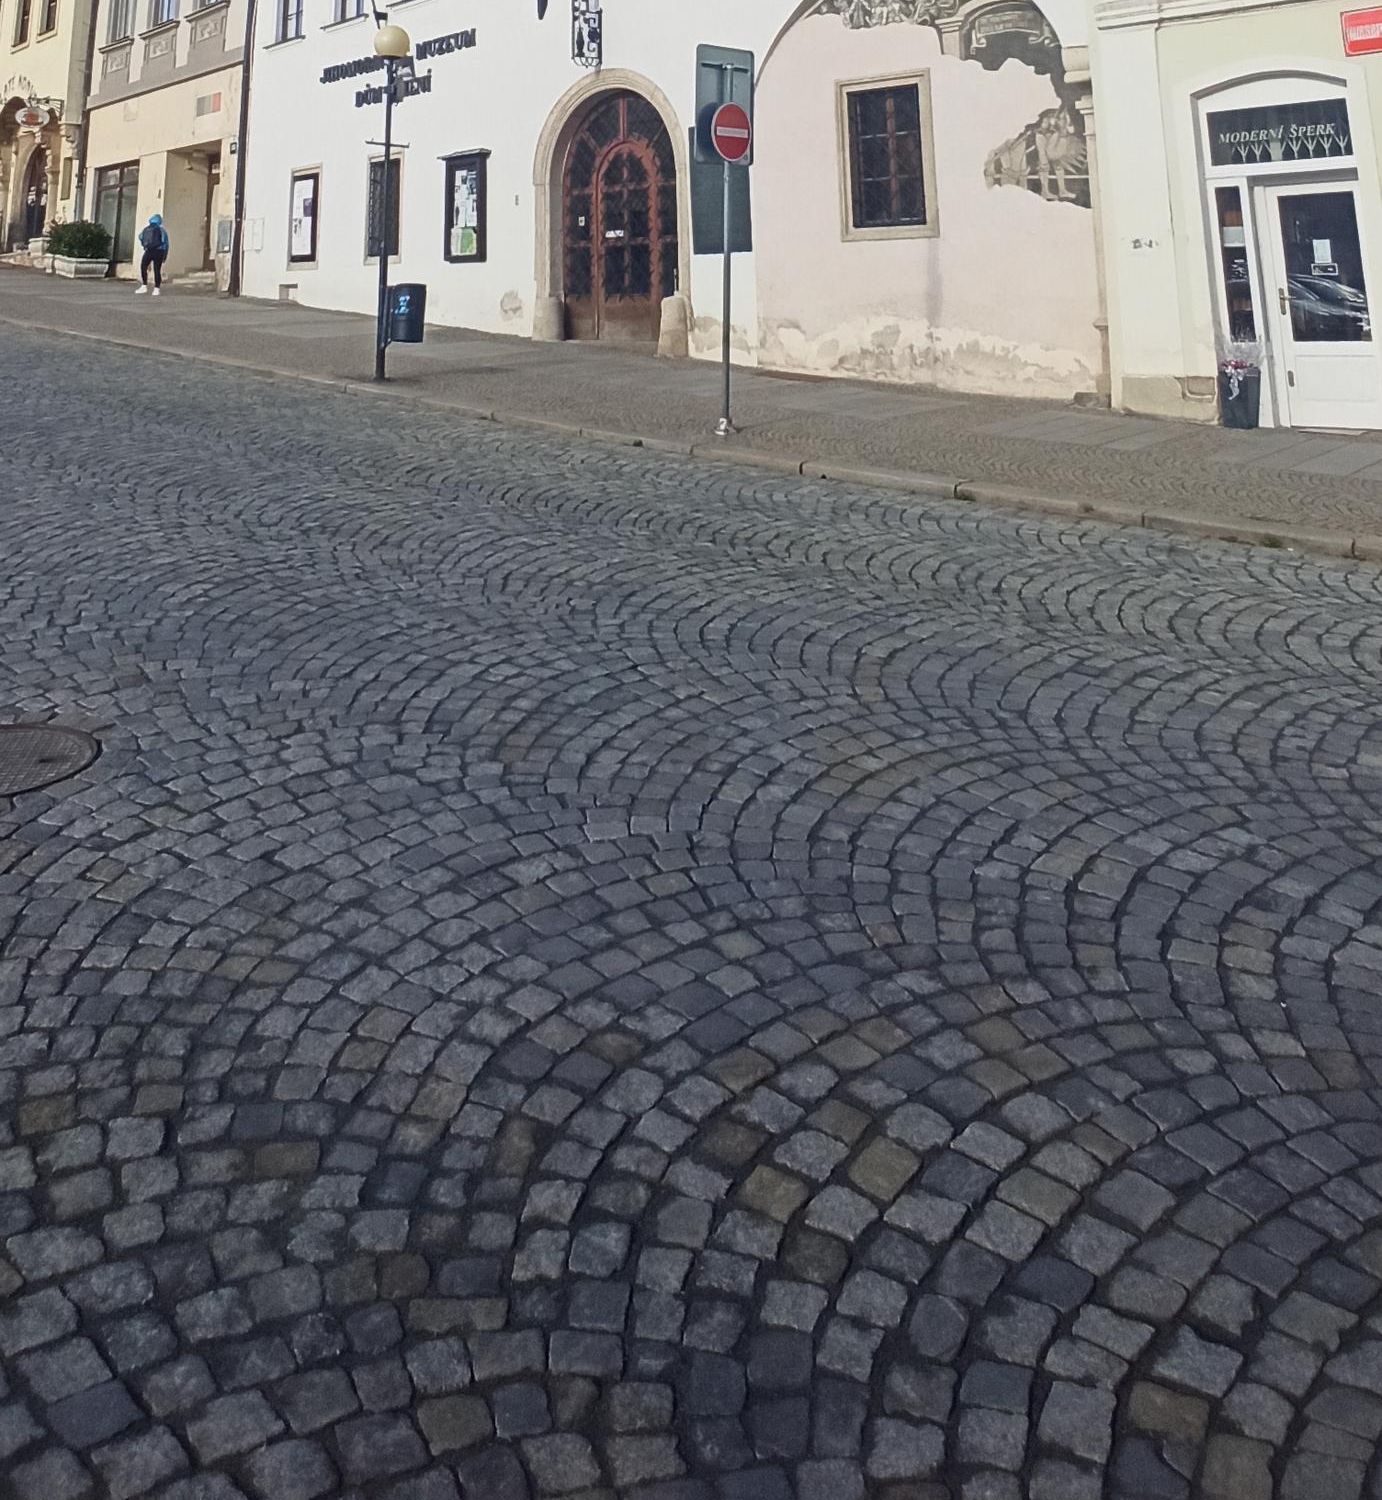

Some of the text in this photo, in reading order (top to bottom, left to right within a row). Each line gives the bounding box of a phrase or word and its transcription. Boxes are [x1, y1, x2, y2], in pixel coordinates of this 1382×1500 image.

[415, 28, 477, 61] MUZEUM
[355, 83, 384, 108] DŮM
[1218, 123, 1335, 144] MODERNÍ ŠPERK
